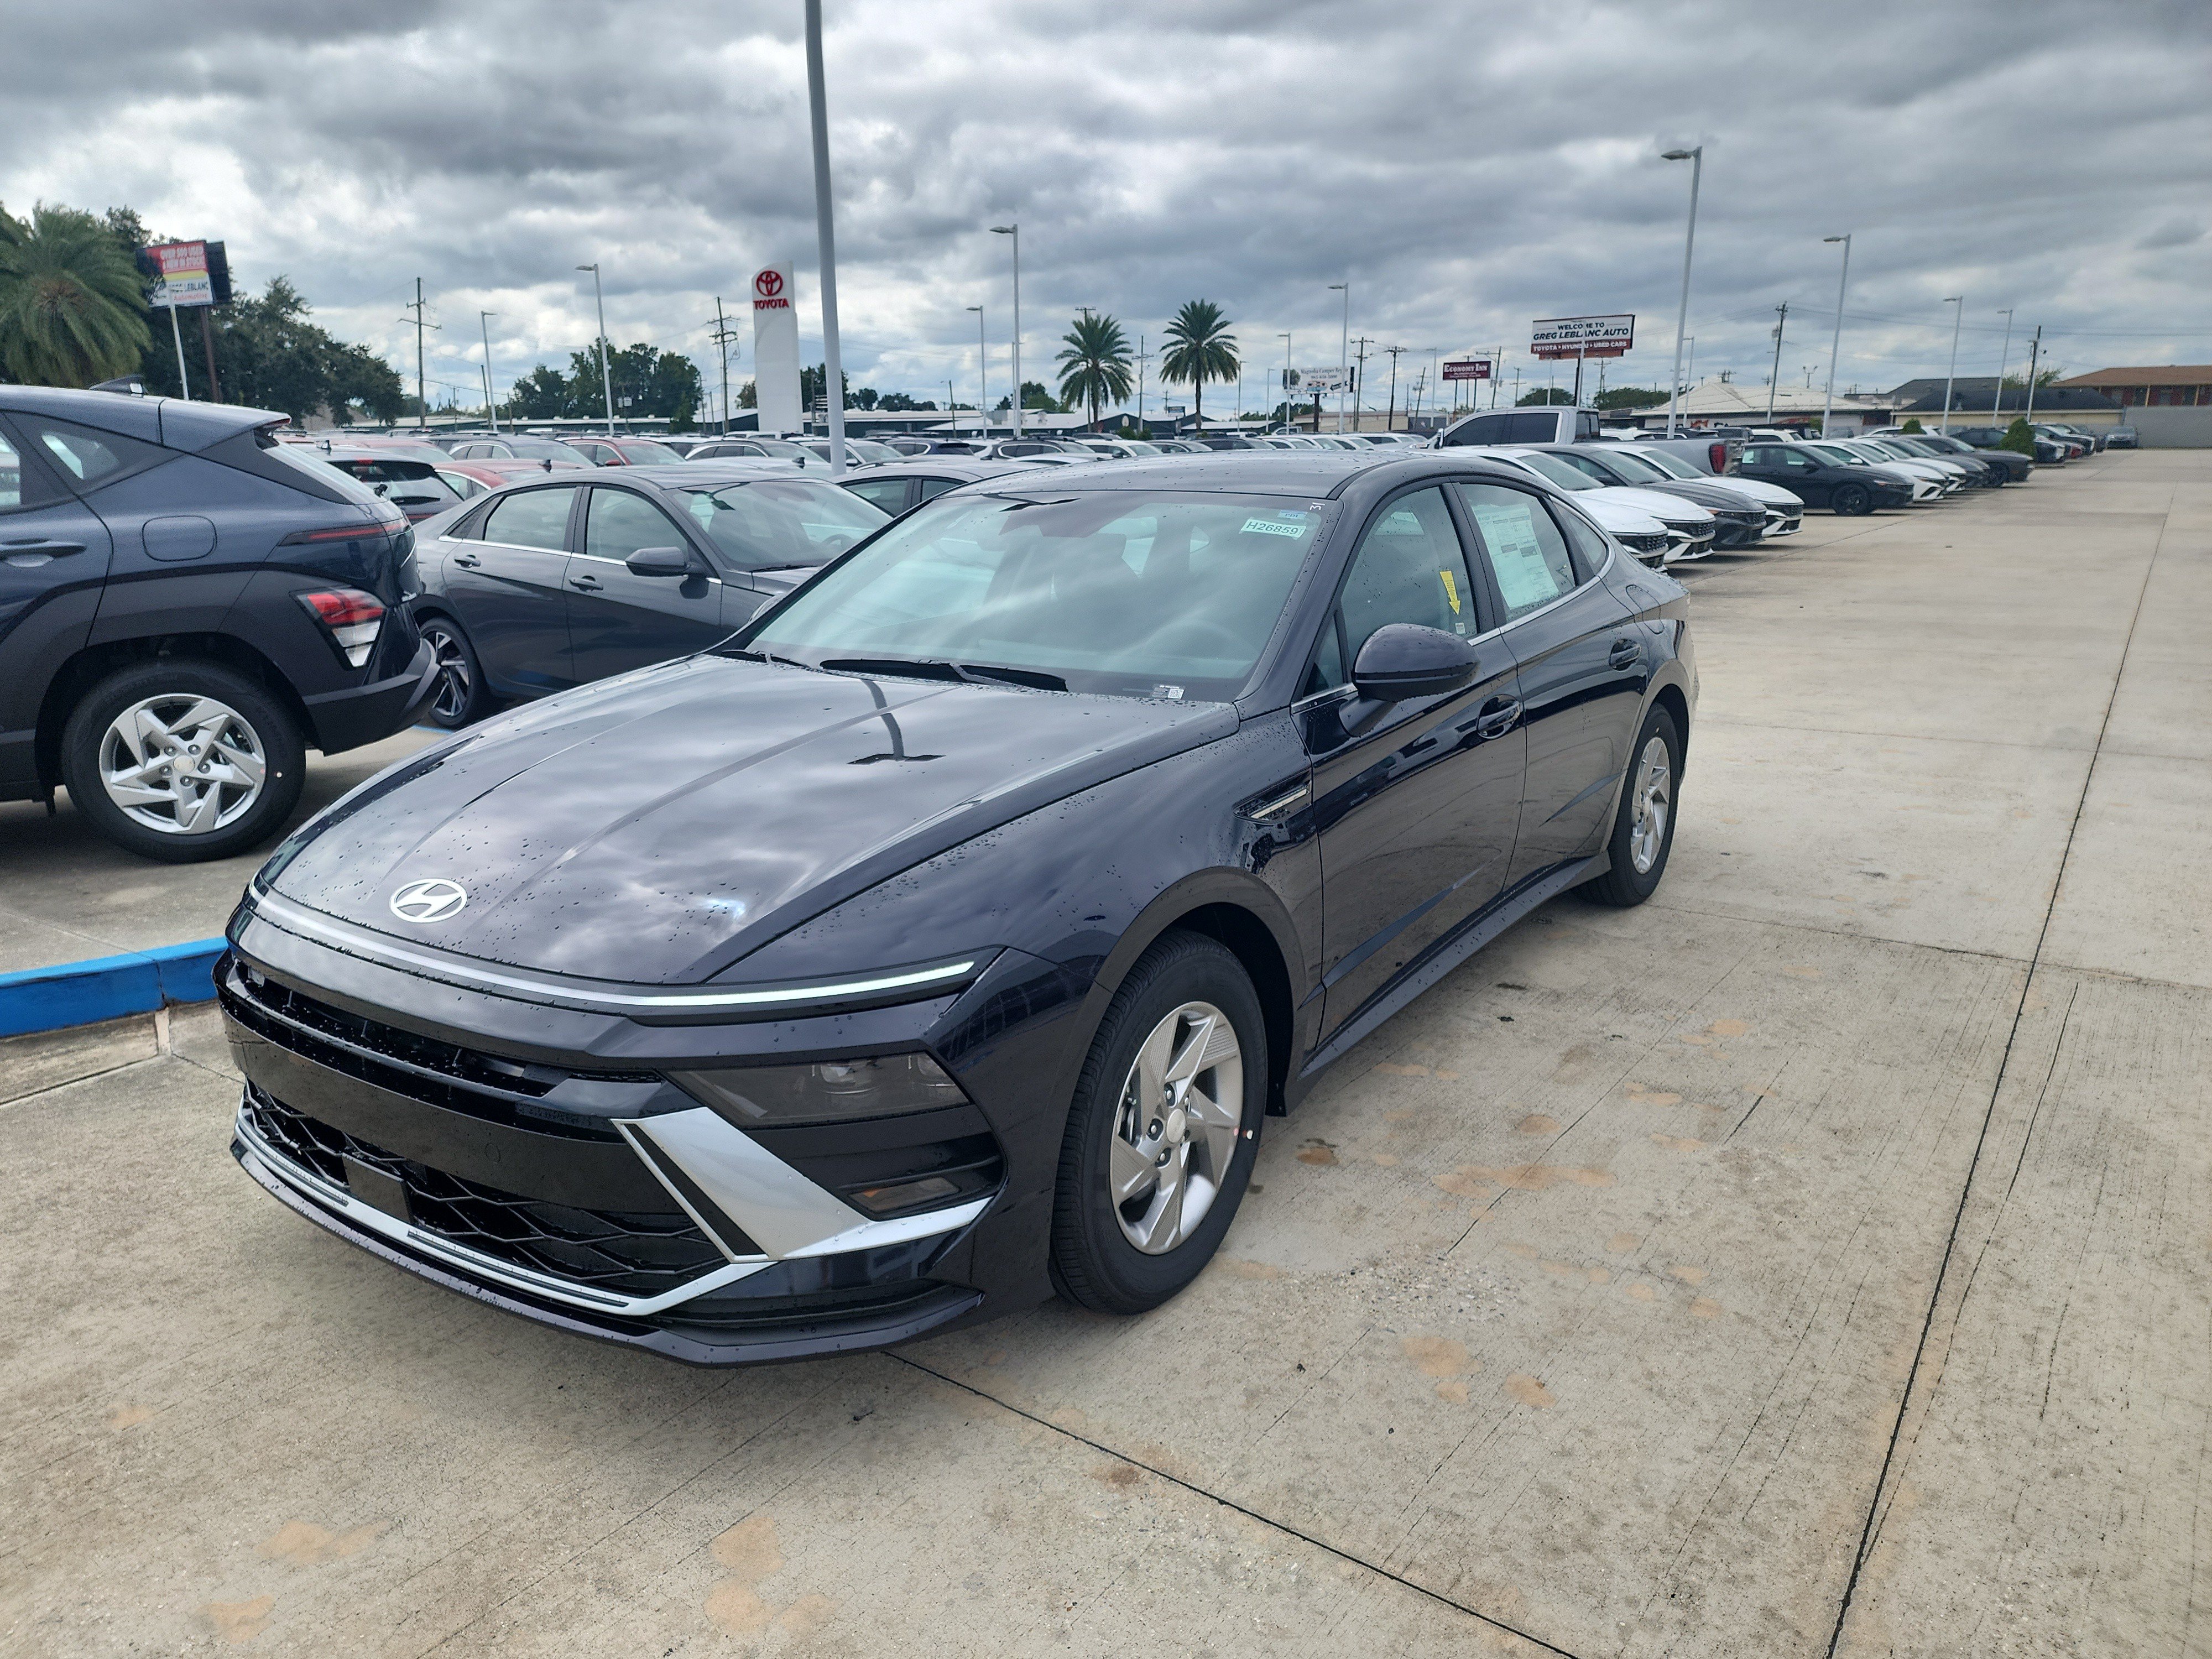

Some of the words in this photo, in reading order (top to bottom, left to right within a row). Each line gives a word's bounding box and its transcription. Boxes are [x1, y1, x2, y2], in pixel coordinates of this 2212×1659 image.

[753, 299, 789, 310] TOYOTA
[1533, 332, 1557, 341] GREG
[1603, 328, 1629, 336] AUTO
